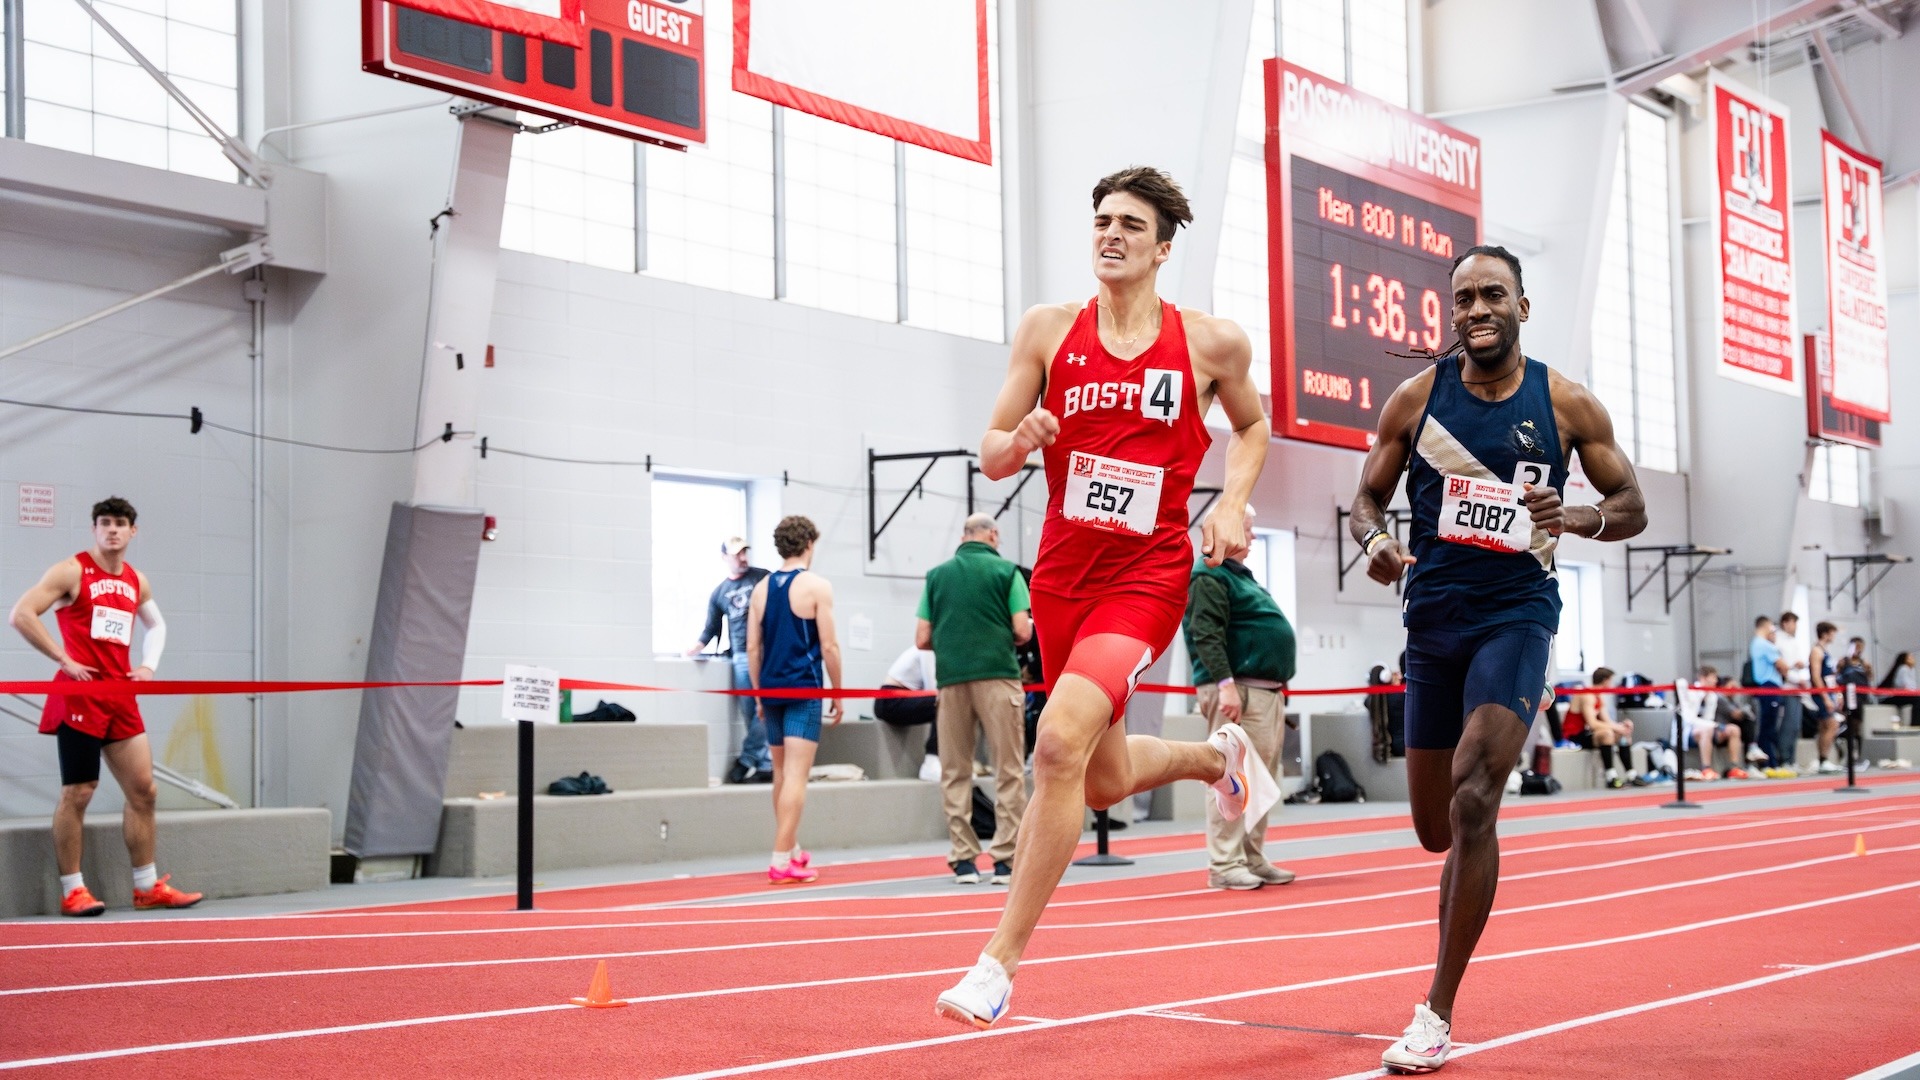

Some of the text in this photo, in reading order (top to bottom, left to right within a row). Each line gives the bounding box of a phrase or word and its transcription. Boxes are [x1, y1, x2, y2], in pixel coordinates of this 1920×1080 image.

[628, 0, 692, 46] GUEST
[1284, 70, 1478, 190] BOSTON UNIVERSITY
[1318, 187, 1453, 258] Men 800 M Run
[1330, 263, 1442, 350] 1:36.9
[1064, 382, 1145, 419] BOST
[1149, 373, 1174, 416] 4
[1303, 369, 1372, 409] ROUND 1
[1075, 456, 1096, 474] BU
[1100, 463, 1156, 479] BOSTON UNIVERSITY
[1086, 481, 1134, 515] 257
[1449, 478, 1471, 495] BU
[1475, 484, 1513, 496] BOSTON UNIV
[1455, 500, 1516, 534] 2087
[89, 578, 136, 604] BOSTON
[105, 620, 123, 636] 272
